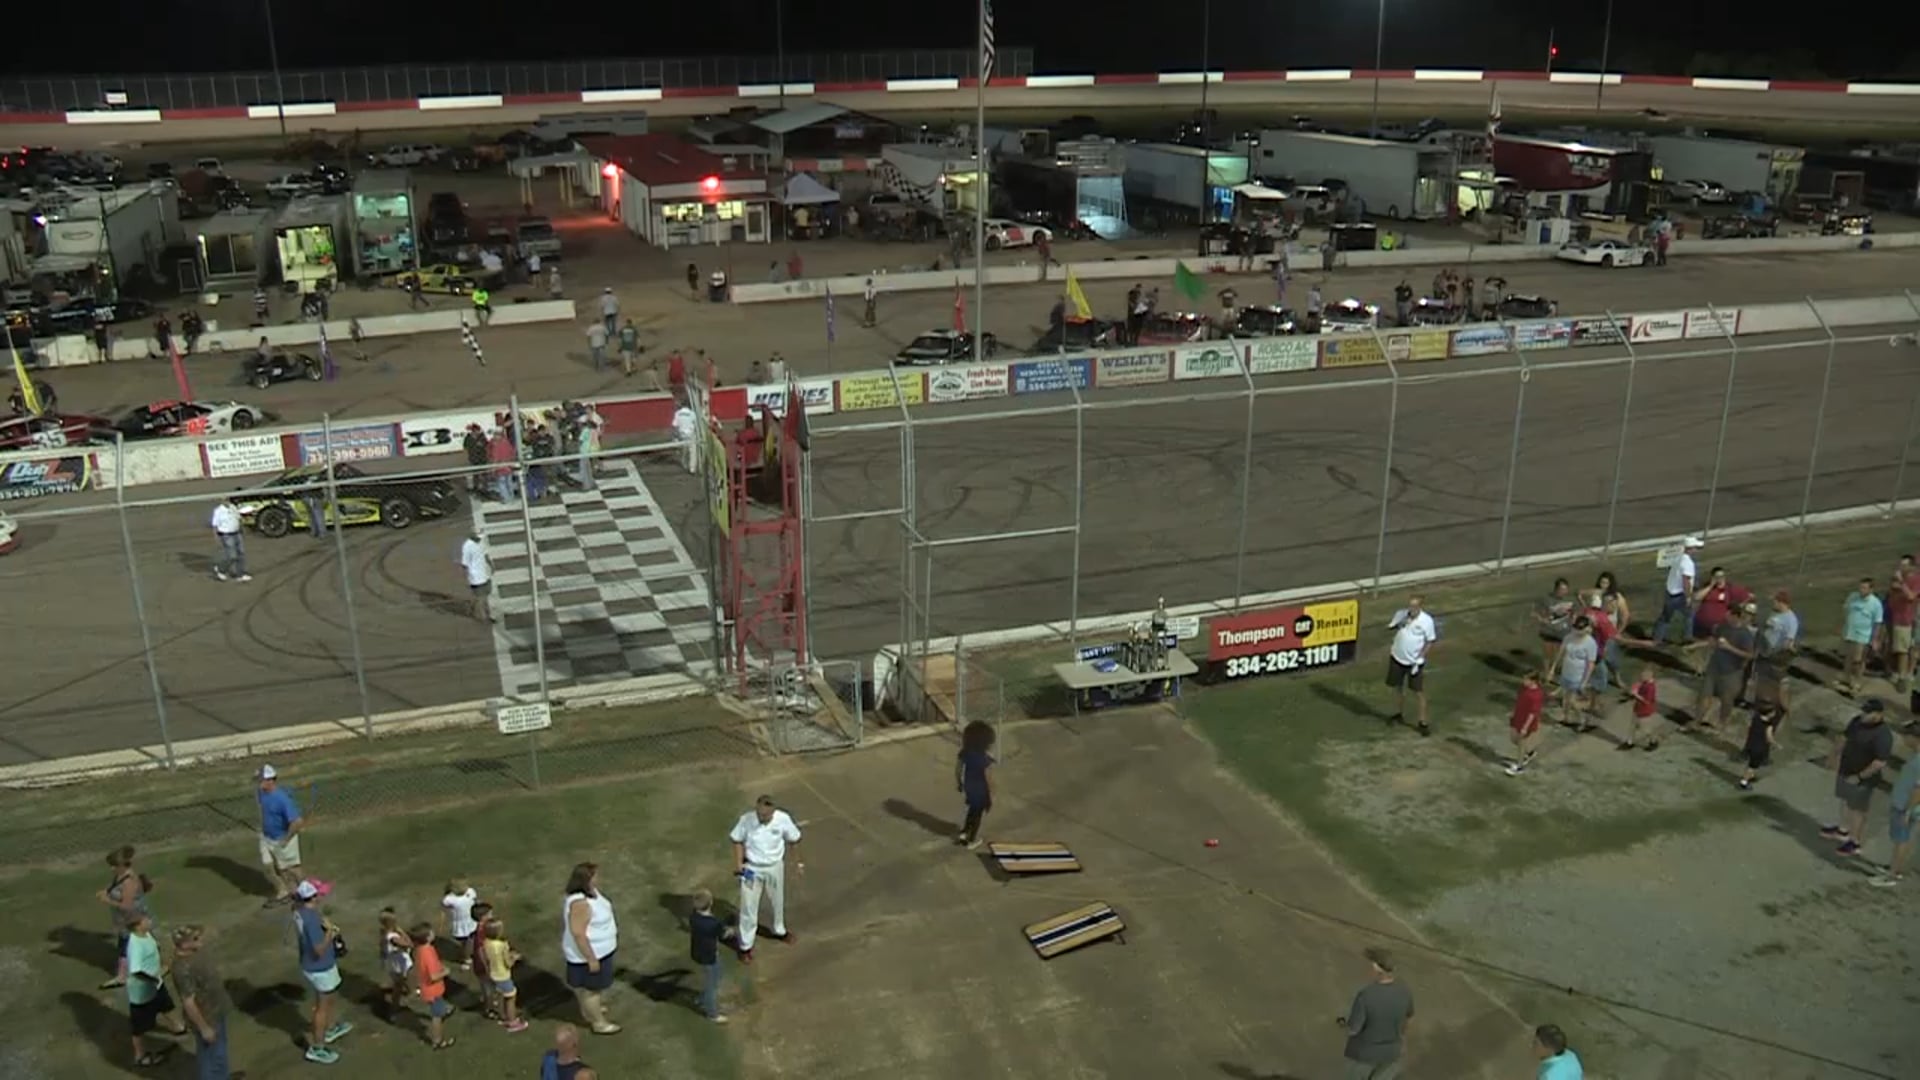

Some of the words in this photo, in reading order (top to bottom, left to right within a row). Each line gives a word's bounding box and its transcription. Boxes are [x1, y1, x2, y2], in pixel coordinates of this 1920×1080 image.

[1101, 353, 1166, 367] WESLEY'S
[33, 430, 67, 449] 35
[208, 442, 229, 451] SEE
[231, 439, 259, 449] THIS
[1218, 624, 1285, 647] Thompson
[1316, 615, 1354, 630] Rental
[1226, 645, 1339, 678] 334-262-1101
